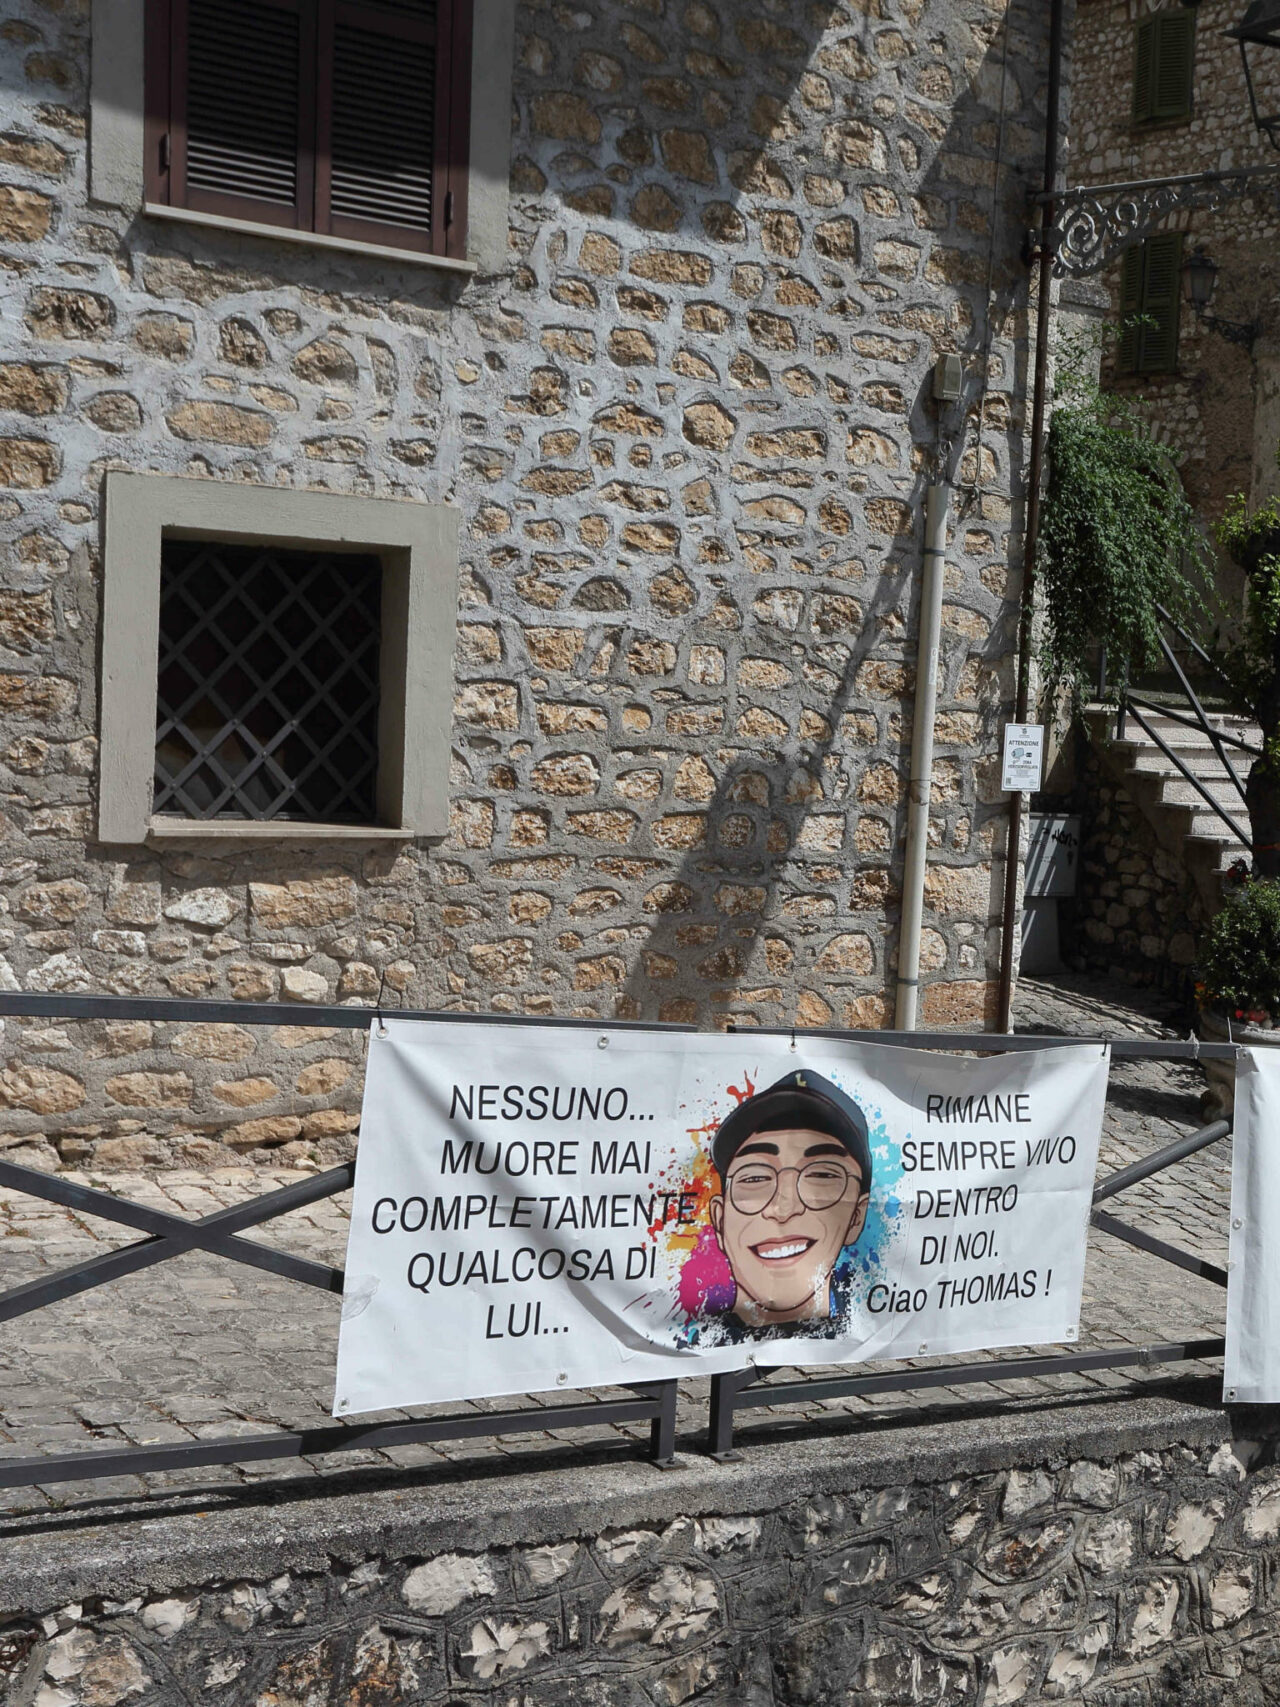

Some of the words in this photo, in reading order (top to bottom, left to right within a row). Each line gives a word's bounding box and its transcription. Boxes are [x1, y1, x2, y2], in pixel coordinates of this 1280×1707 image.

[448, 1085, 655, 1120] NESSUNO...
[926, 1094, 1031, 1123] RIMANE
[440, 1140, 579, 1174] MUORE
[590, 1141, 651, 1174] MAI
[901, 1140, 1016, 1172] SEMPRE
[1024, 1135, 1076, 1167] VIVO
[371, 1192, 698, 1234] COMPLETAMENTE
[914, 1184, 1018, 1219] DENTRO
[920, 1235, 945, 1265] DI
[953, 1231, 998, 1261] NOI.
[407, 1248, 615, 1293] QUALCOSA
[625, 1246, 656, 1280] DI
[866, 1284, 928, 1313] Ciao
[937, 1269, 1037, 1309] THOMAS
[485, 1301, 569, 1339] LUI...
